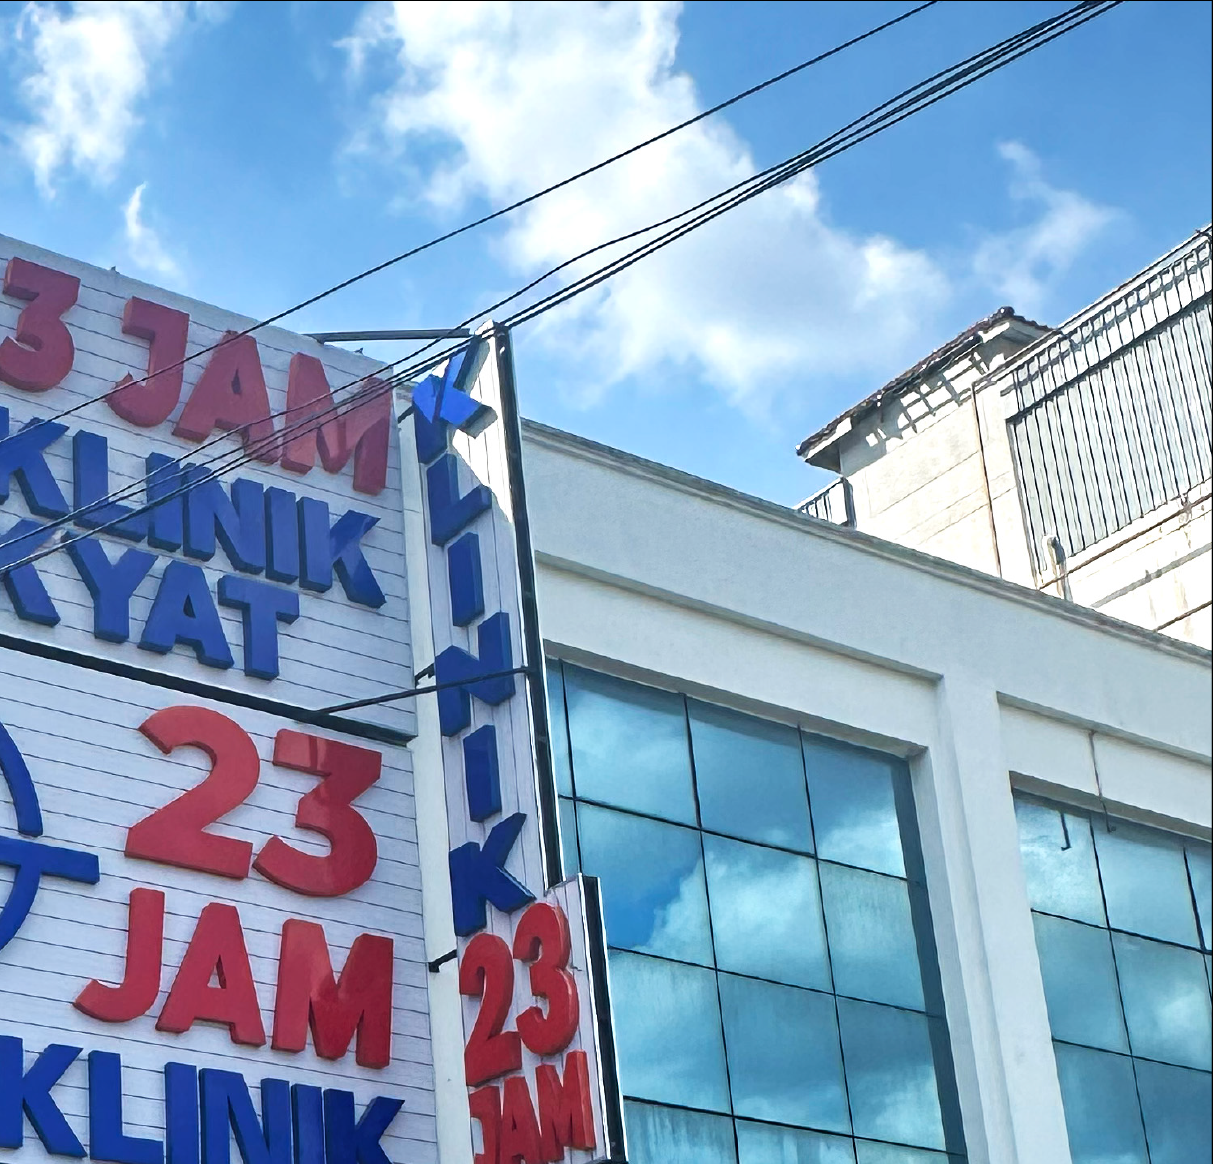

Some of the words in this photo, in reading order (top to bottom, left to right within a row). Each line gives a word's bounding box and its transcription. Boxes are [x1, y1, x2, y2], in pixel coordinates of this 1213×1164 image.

[105, 296, 390, 496] JAM
[412, 336, 537, 938] KLINIK
[124, 705, 383, 898] 23
[73, 887, 394, 1069] JAM
[459, 902, 581, 1087] 23
